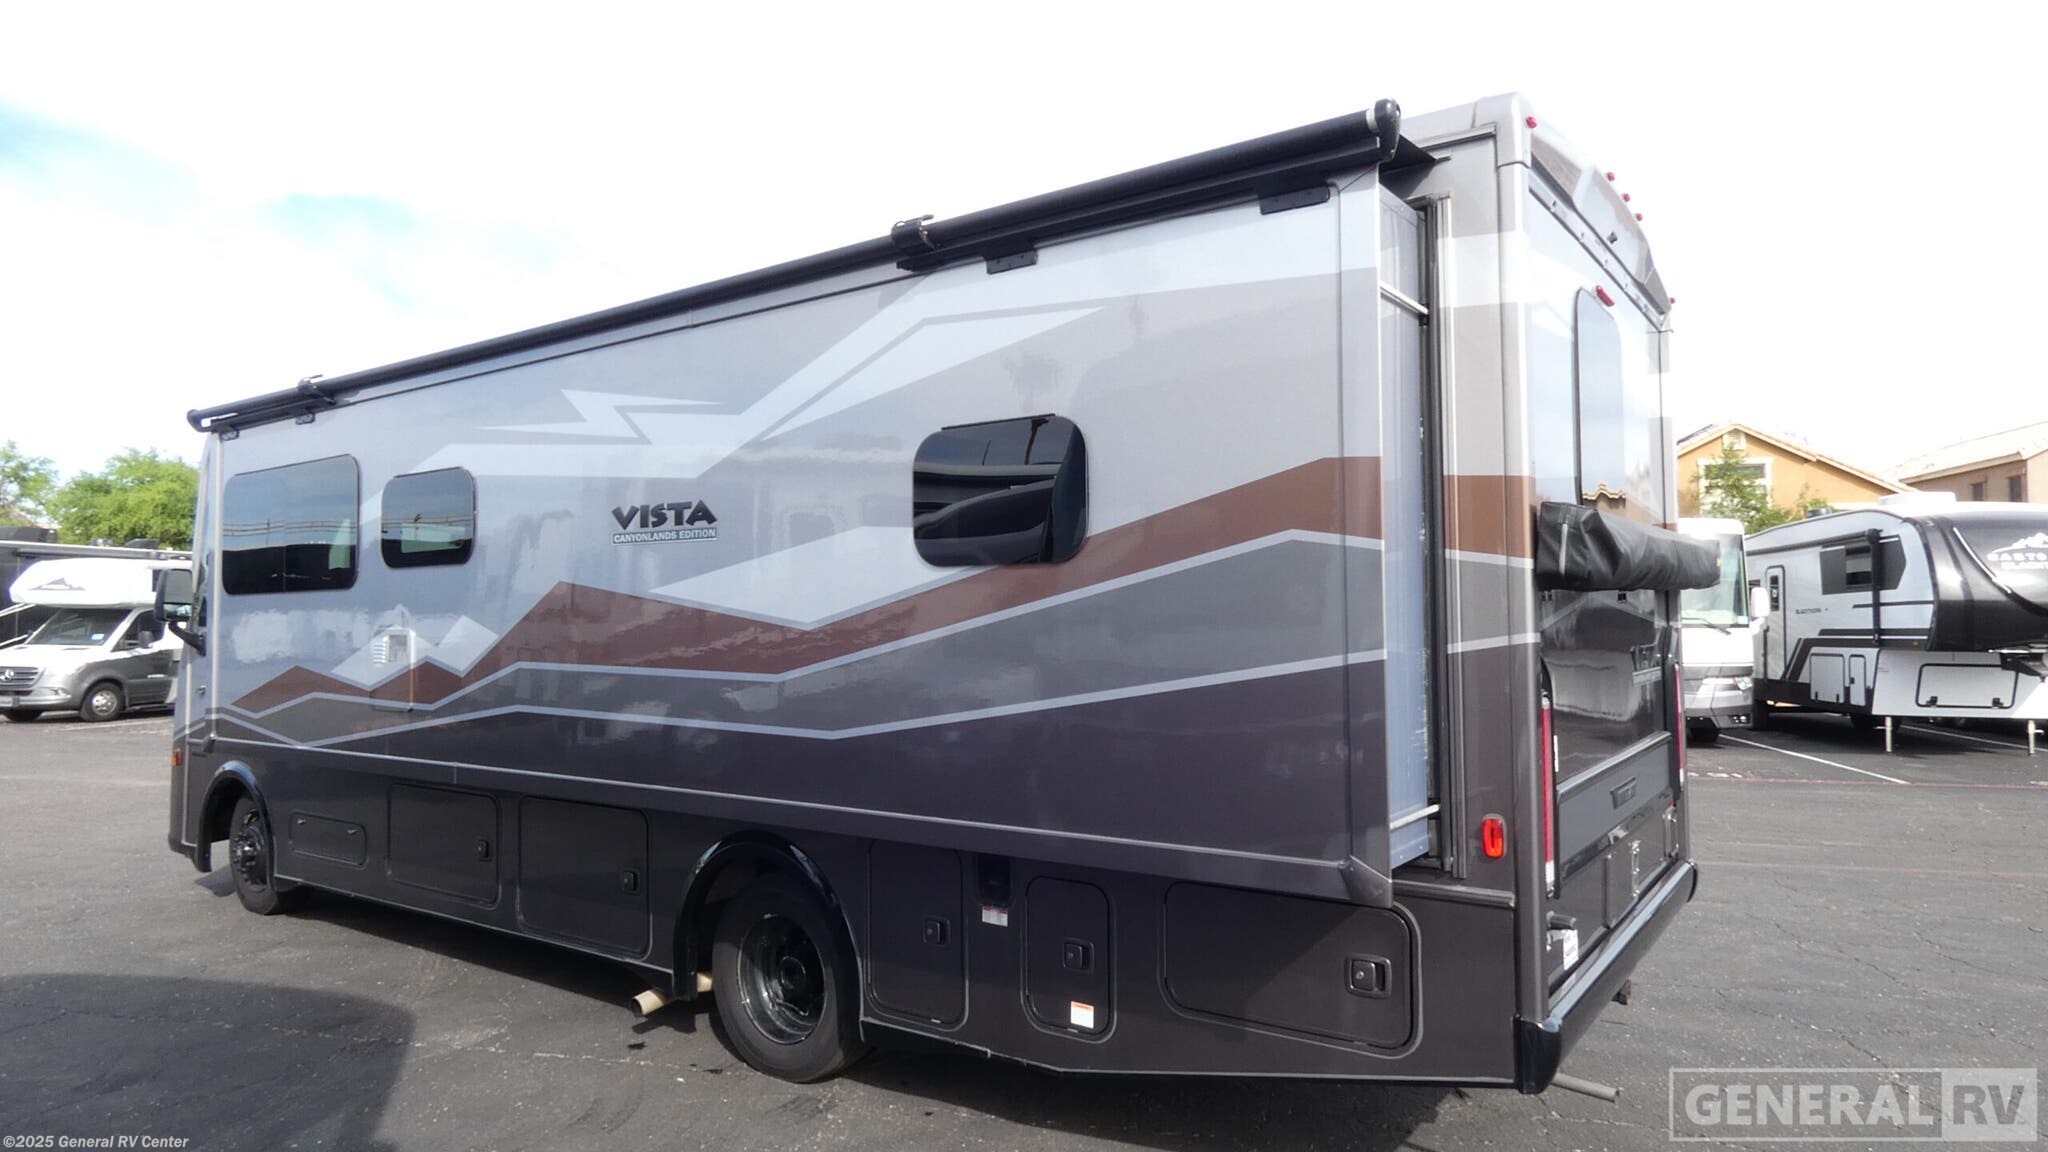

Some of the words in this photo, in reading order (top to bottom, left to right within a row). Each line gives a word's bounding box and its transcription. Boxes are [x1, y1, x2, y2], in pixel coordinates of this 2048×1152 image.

[611, 500, 717, 530] VISTA
[614, 532, 677, 542] CANYONLANDS
[680, 529, 715, 539] EDITION
